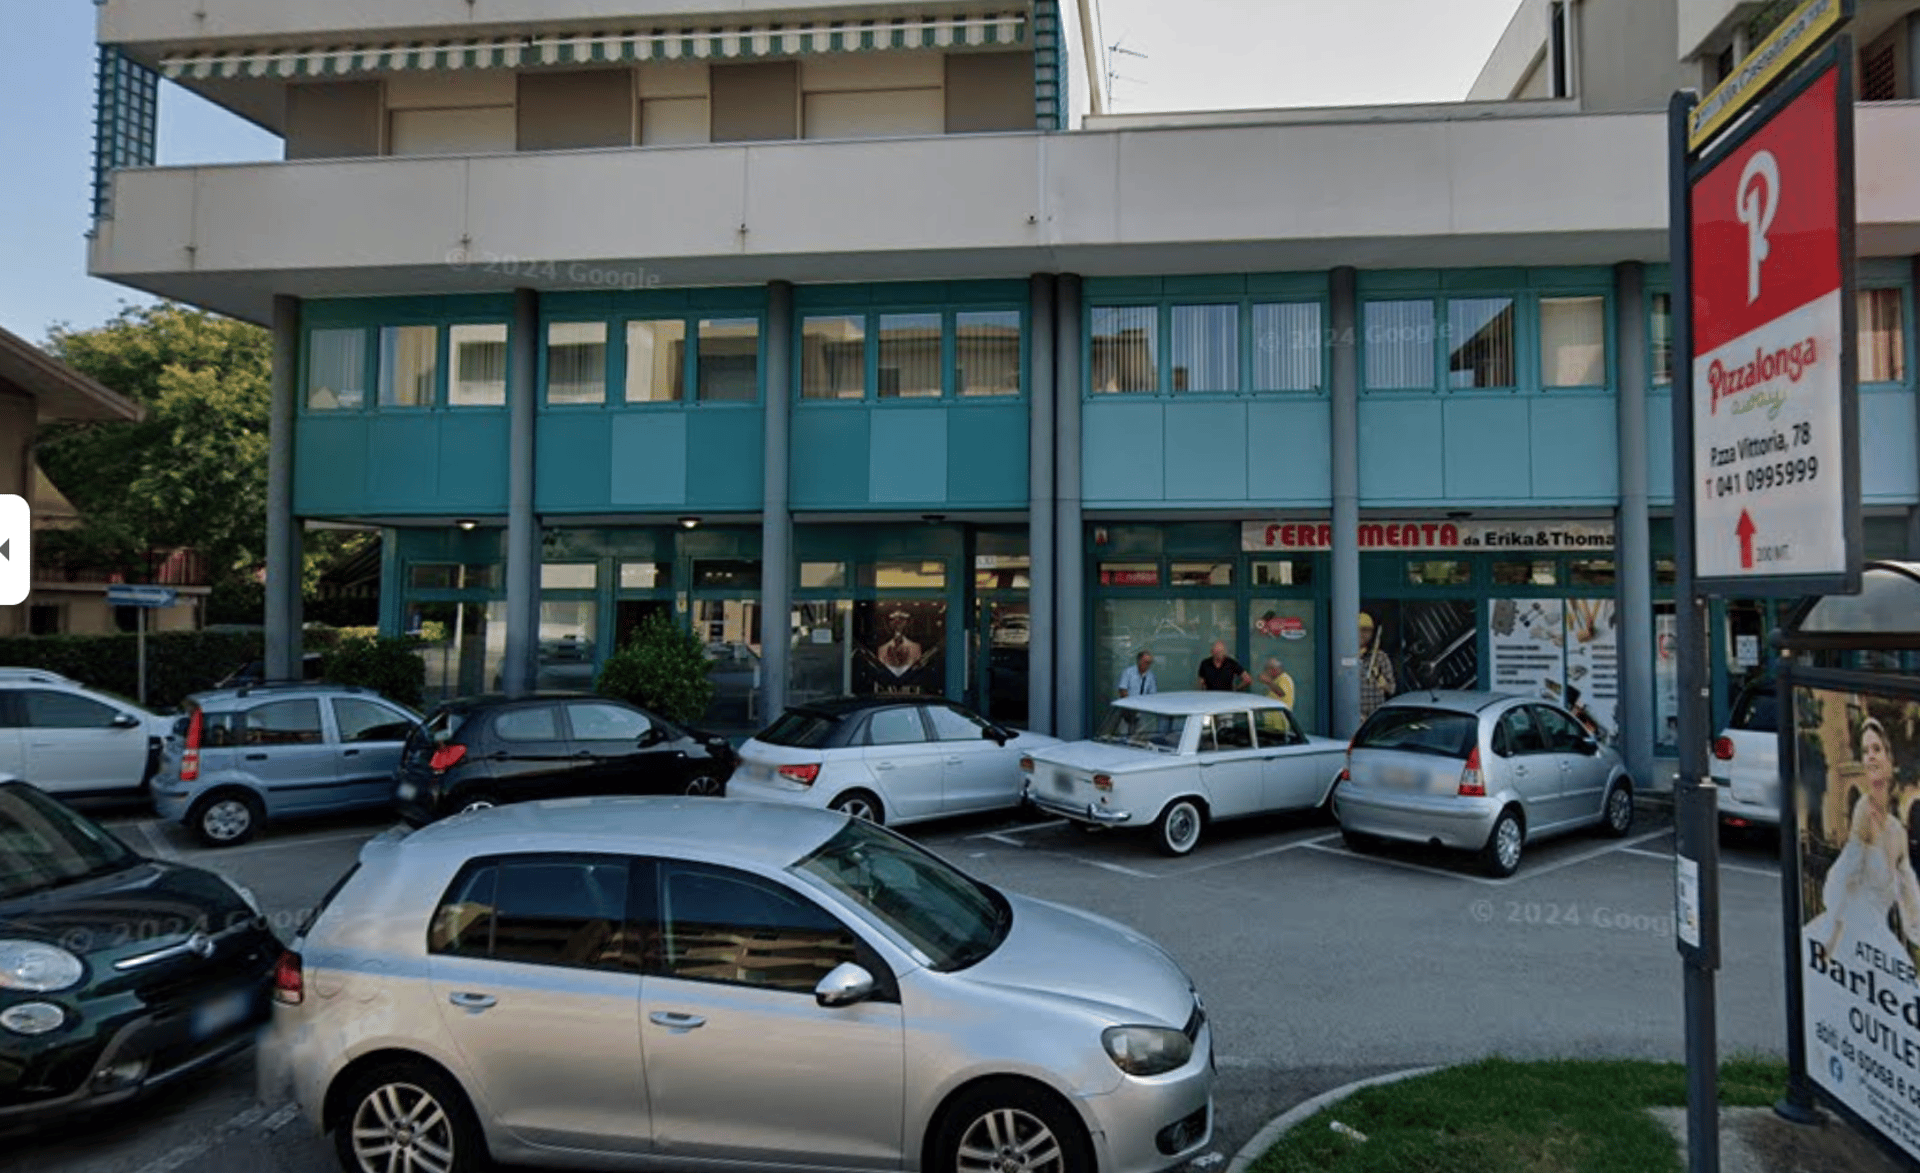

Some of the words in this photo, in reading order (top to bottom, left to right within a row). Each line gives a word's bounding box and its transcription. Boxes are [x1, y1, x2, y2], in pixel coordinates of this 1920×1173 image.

[1708, 336, 1817, 416] Pizzalonga
[1792, 421, 1811, 447] 78
[1716, 474, 1741, 498] 041
[1746, 455, 1818, 492] 0995999
[1265, 522, 1459, 547] FERRMENTA
[1463, 535, 1479, 547] da
[1855, 940, 1919, 989] ATELIER
[1897, 1076, 1905, 1098] e
